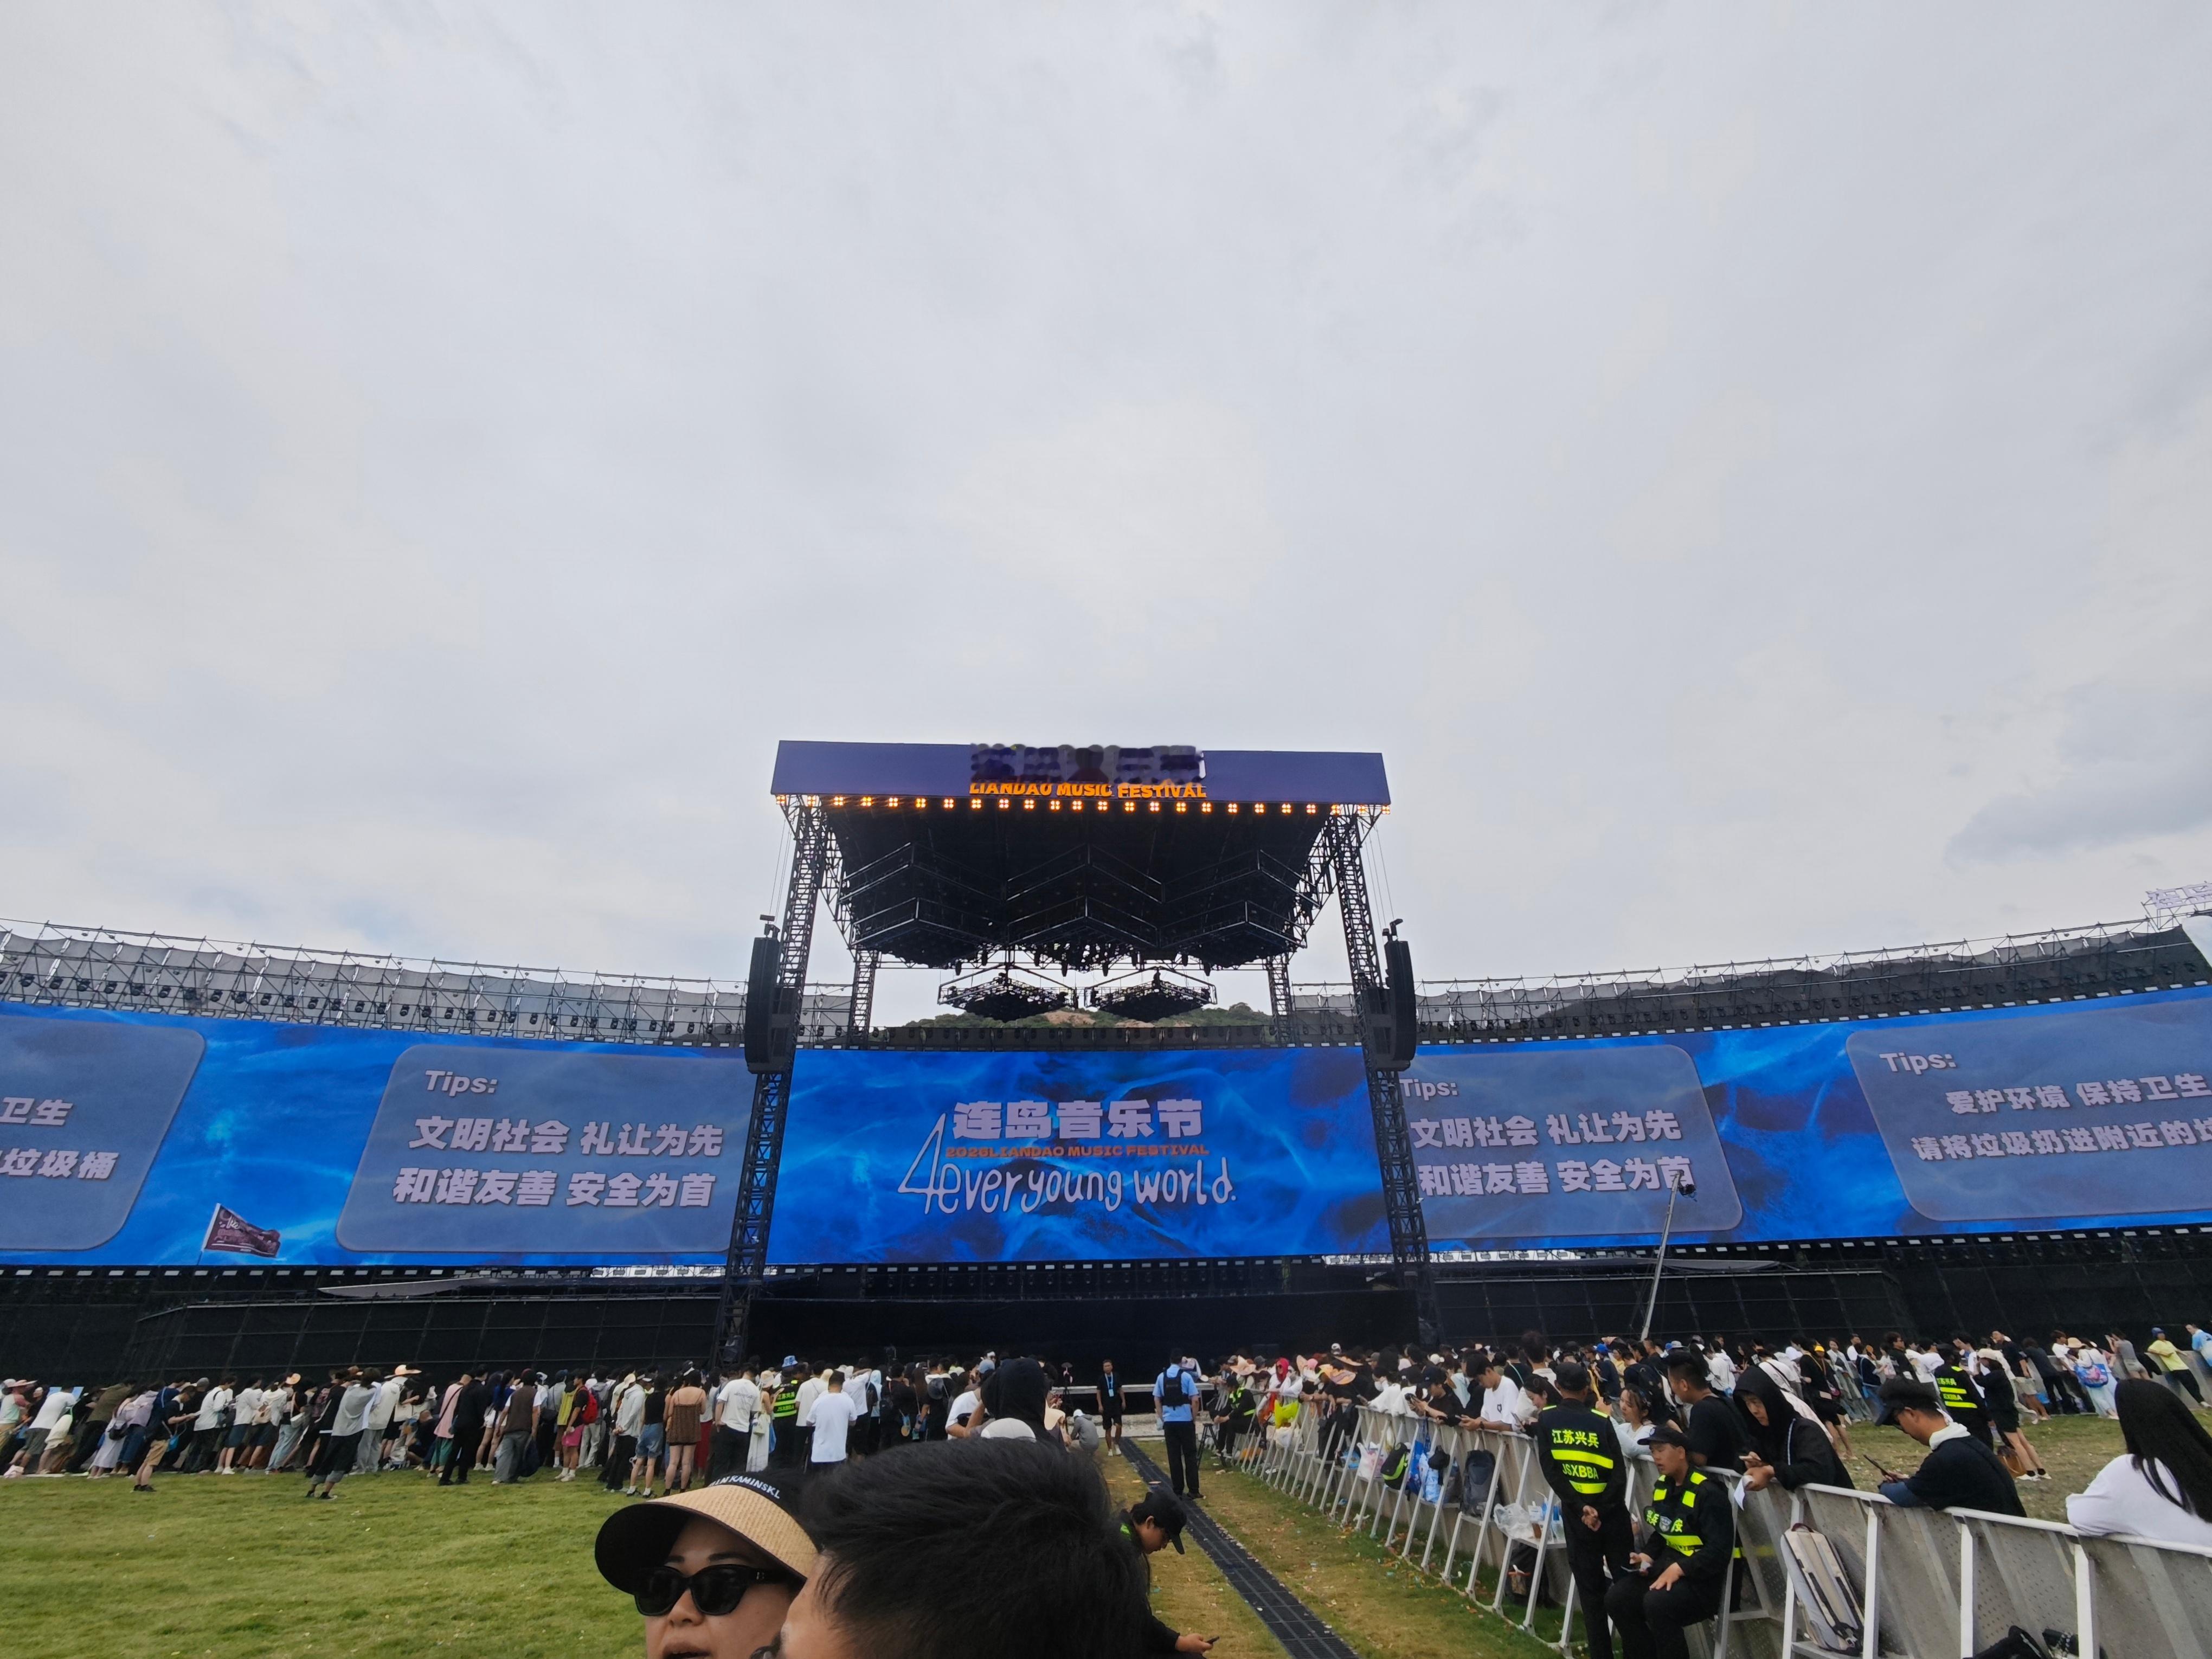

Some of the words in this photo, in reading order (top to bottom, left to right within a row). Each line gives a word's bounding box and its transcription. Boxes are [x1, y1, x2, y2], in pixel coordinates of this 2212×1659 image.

[969, 782, 1052, 796] LIANDAO
[1056, 782, 1113, 798] MUSIC
[1117, 780, 1207, 799] FESTIVAL
[1879, 1052, 1956, 1075] Tips:
[425, 1070, 498, 1097] Tips:
[1399, 1078, 1458, 1101] Tips:
[1945, 1084, 2070, 1115] 爱护环境
[2076, 1073, 2212, 1106] 保持卫生
[0, 1097, 74, 1126] 卫生
[953, 1098, 1203, 1139] 连岛音乐节
[408, 1115, 570, 1154] 文明社会
[580, 1121, 723, 1156] 礼让为先
[1410, 1115, 1539, 1148] 文明社会
[1545, 1109, 1682, 1145] 礼让为先
[0, 1148, 119, 1179] 垃圾桶
[1068, 1145, 1123, 1157] MUSIC
[1126, 1143, 1210, 1156] FESTIVAL
[393, 1167, 558, 1205] 和谐友善
[565, 1171, 716, 1207] 安全为首
[1134, 1156, 1237, 1205] world.
[1417, 1161, 1549, 1196] 和谐友善
[1556, 1155, 1695, 1193] 安全为首
[1552, 1429, 1599, 1448] 江苏兴兵
[1562, 1463, 1599, 1480] JSXBBA
